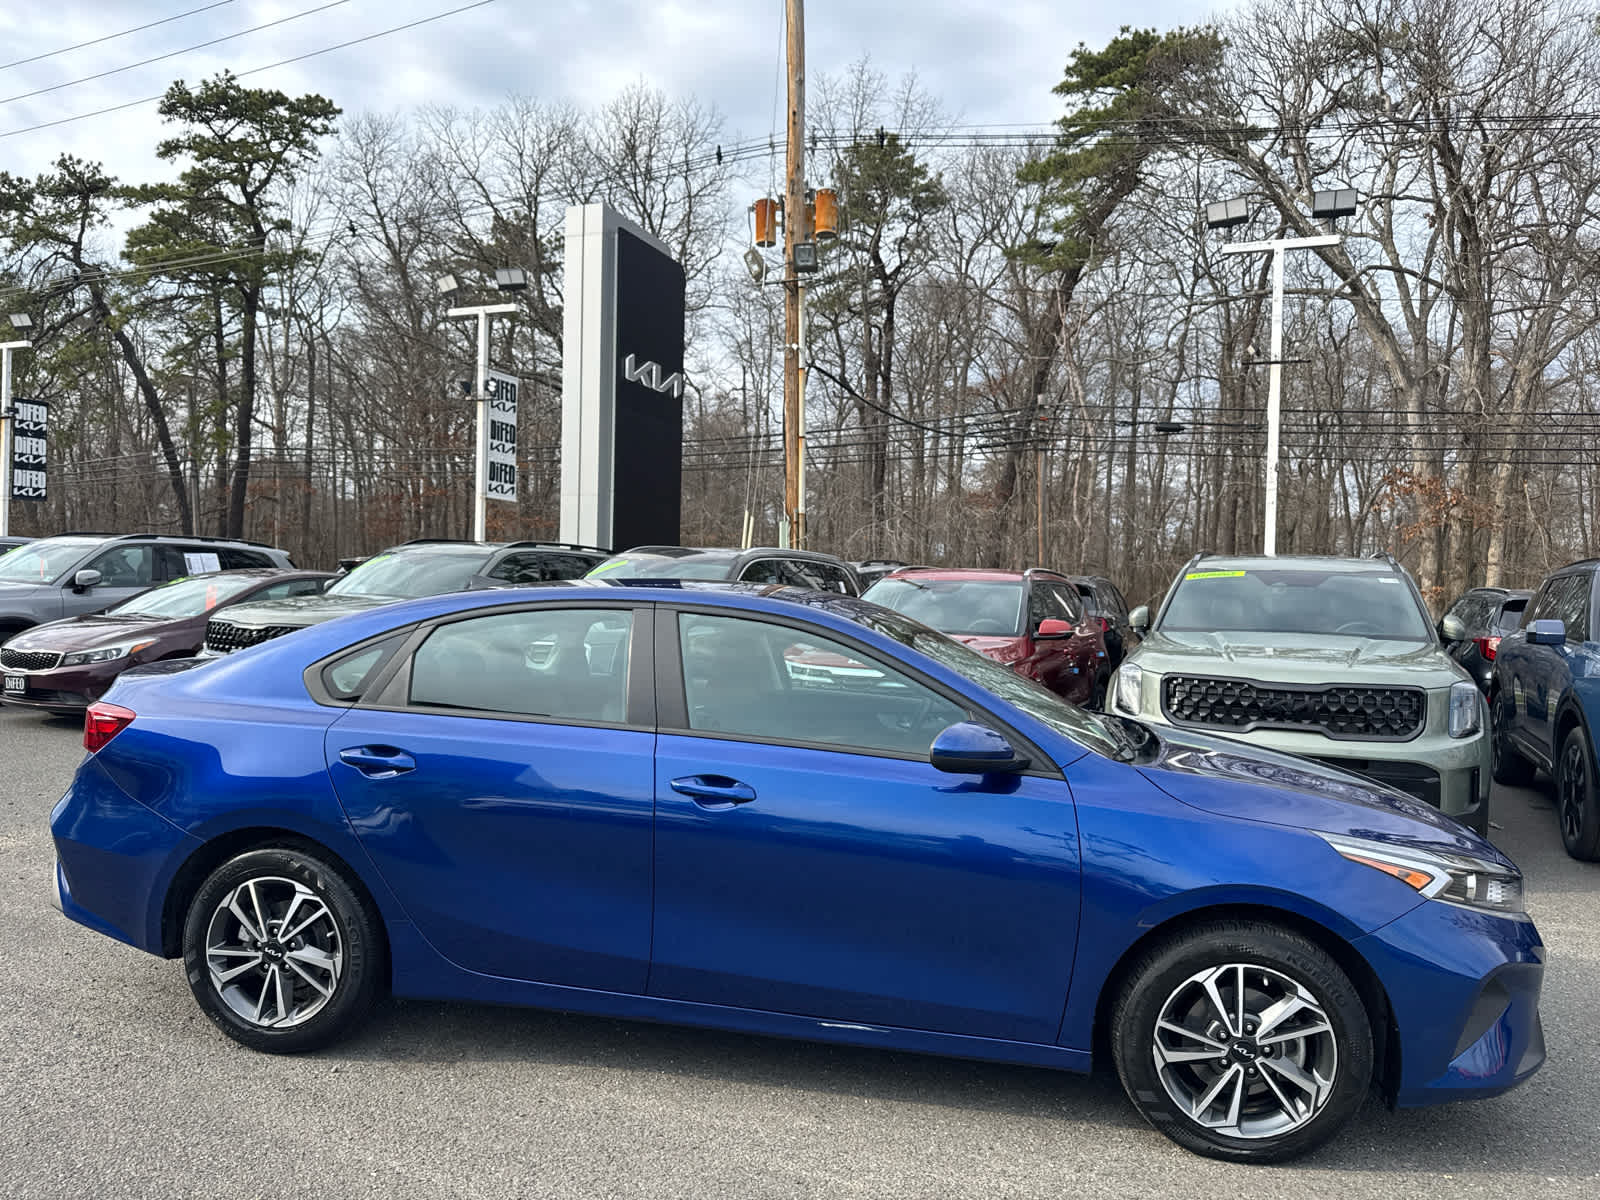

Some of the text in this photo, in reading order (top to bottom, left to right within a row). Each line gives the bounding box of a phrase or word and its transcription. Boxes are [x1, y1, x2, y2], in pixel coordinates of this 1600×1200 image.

[625, 353, 682, 399] KIA
[490, 400, 516, 413] KIA
[14, 420, 47, 431] KIA
[489, 442, 515, 454] KIA
[14, 453, 47, 464] KIA
[13, 486, 46, 497] KIA
[488, 483, 515, 495] KIA
[264, 946, 282, 958] KIA
[1233, 1044, 1255, 1059] KIA
